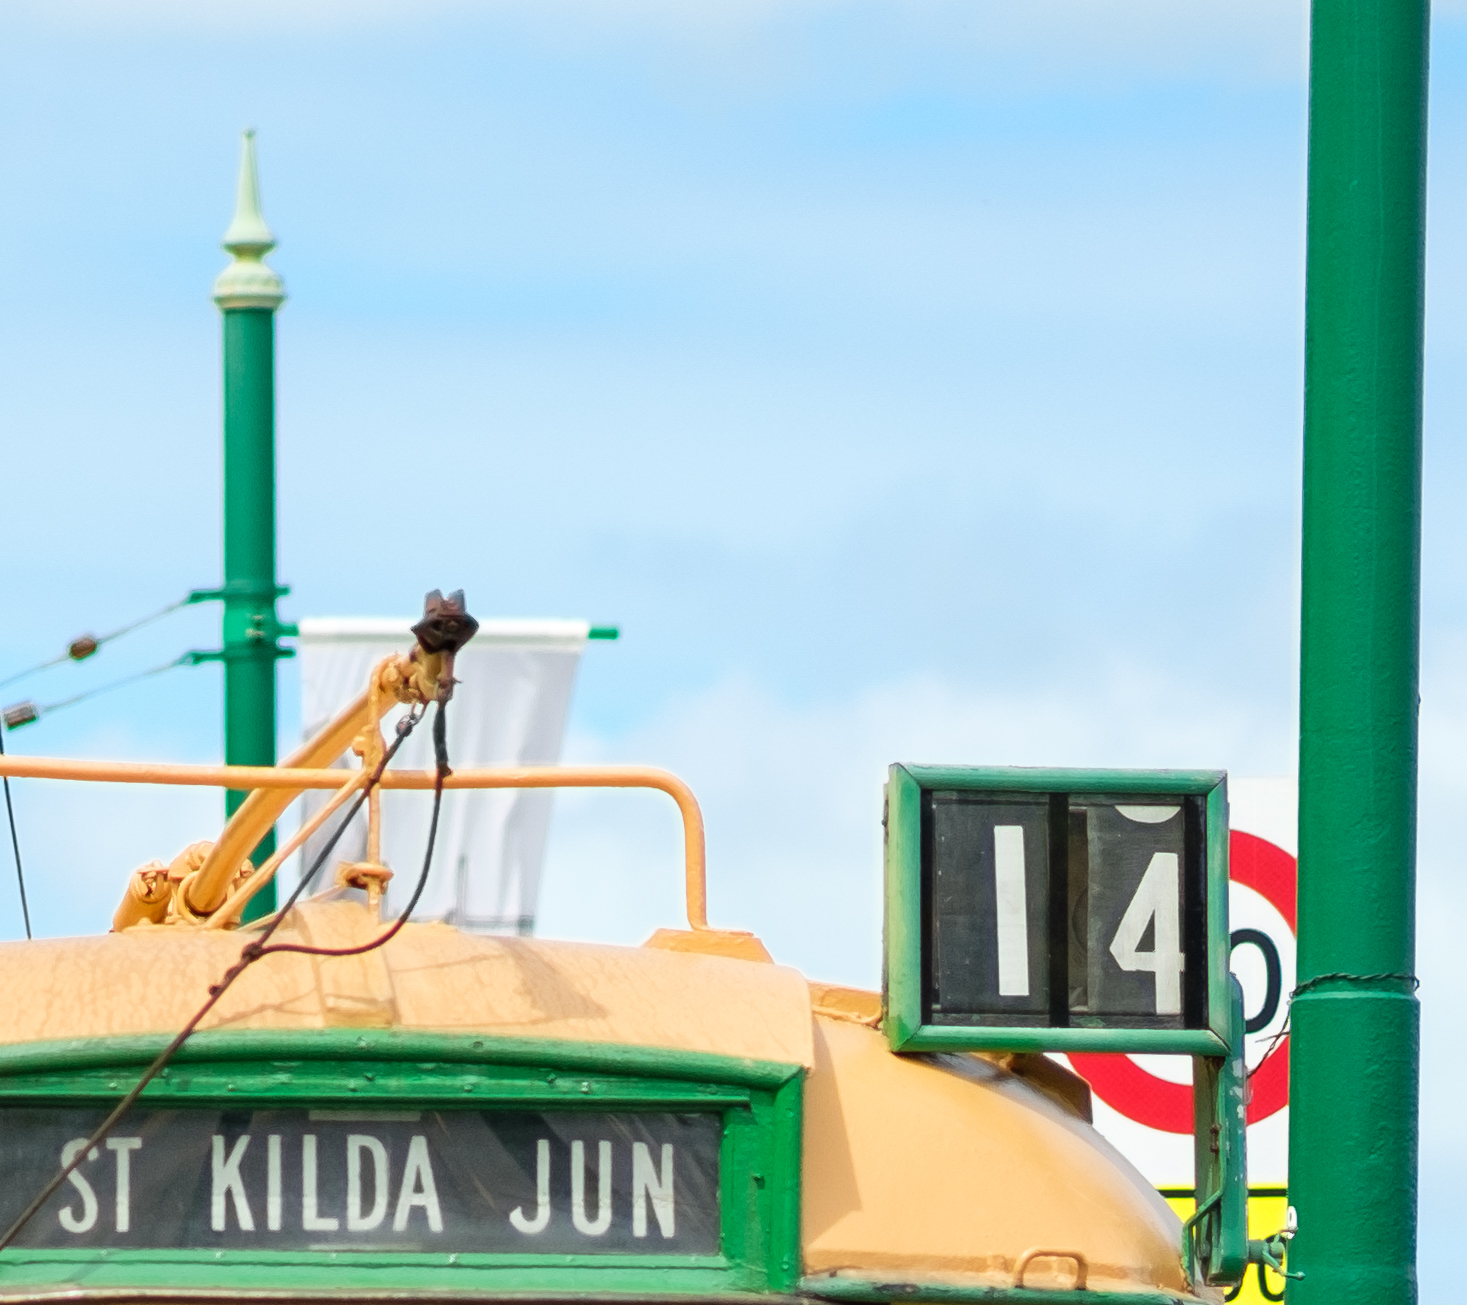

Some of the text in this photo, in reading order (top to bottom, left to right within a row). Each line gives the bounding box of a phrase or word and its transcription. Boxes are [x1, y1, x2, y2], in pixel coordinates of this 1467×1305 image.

[1228, 928, 1282, 1034] 0
[57, 1134, 676, 1239] ST KILDA JUN
